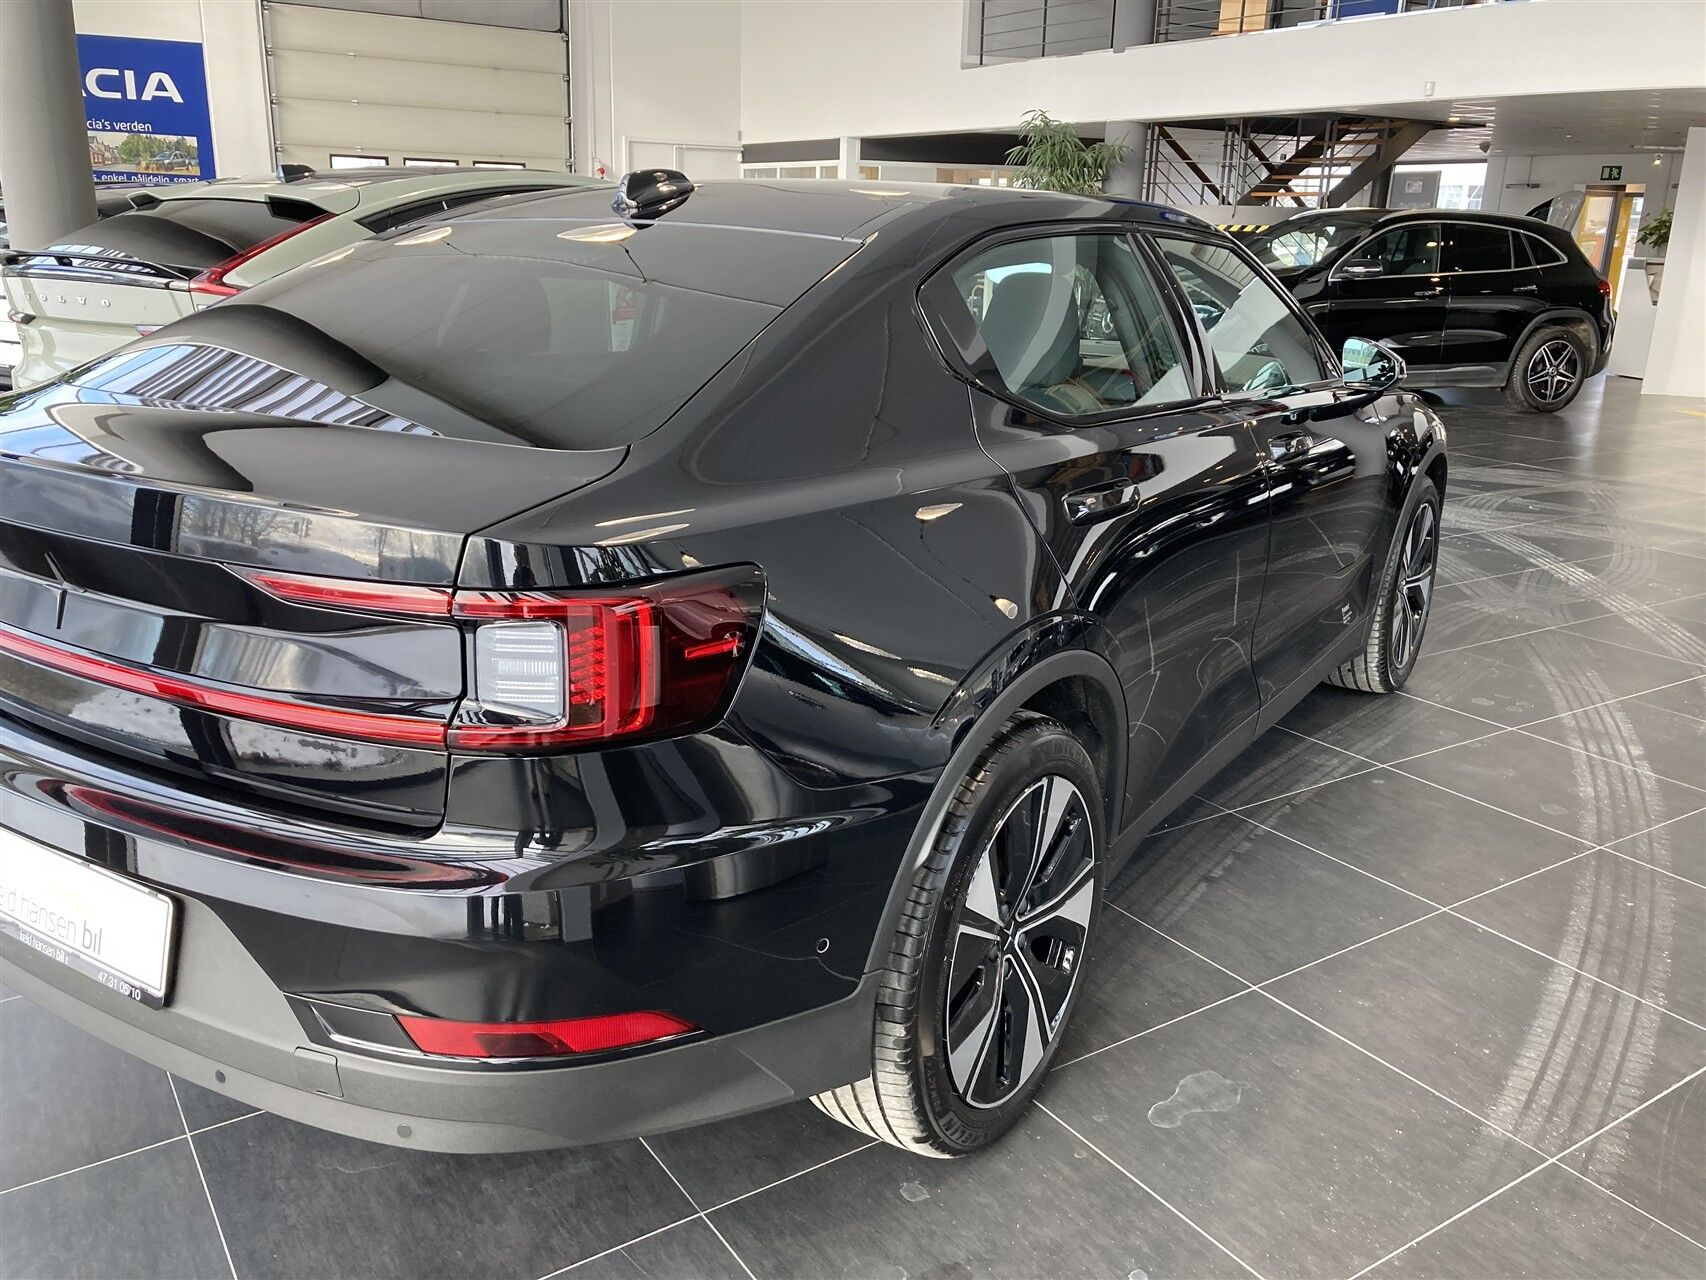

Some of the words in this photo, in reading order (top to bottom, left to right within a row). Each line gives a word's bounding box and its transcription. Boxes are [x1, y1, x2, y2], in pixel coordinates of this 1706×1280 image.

[81, 67, 185, 104] CIA
[86, 118, 111, 130] cia's
[113, 120, 152, 132] verden
[24, 292, 111, 308] VOLVO
[98, 972, 108, 984] 47
[108, 976, 118, 990] 31
[130, 987, 141, 1001] 10
